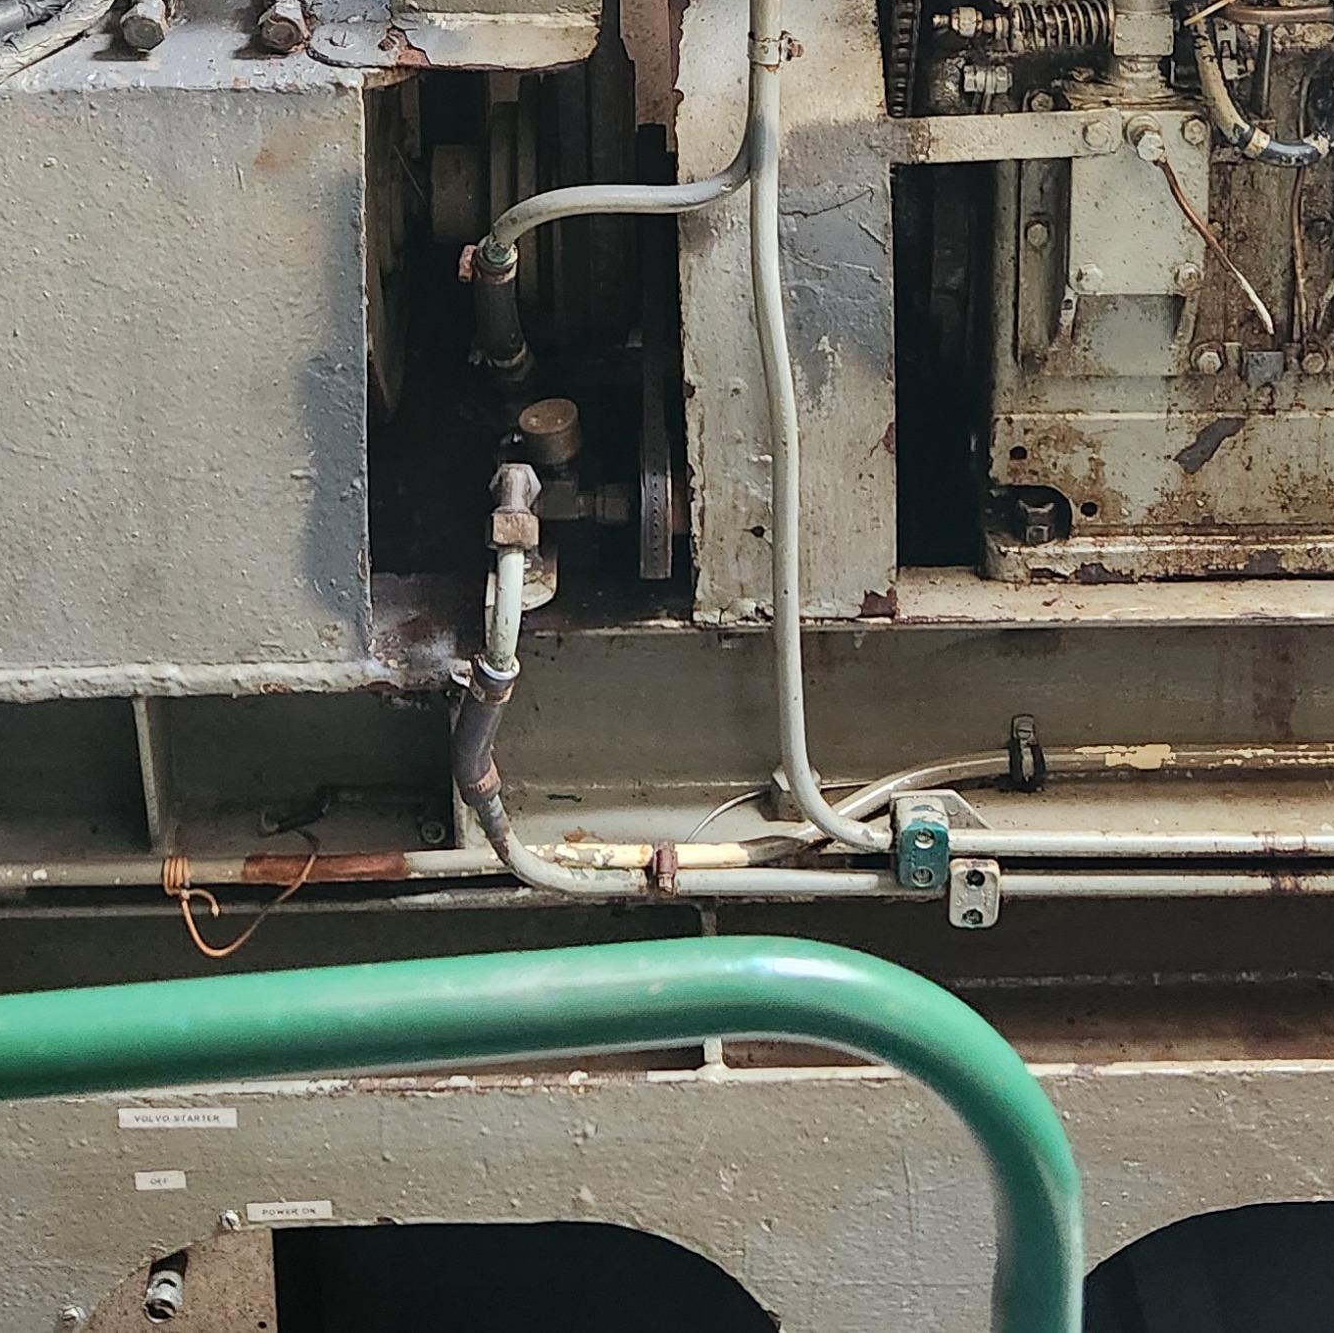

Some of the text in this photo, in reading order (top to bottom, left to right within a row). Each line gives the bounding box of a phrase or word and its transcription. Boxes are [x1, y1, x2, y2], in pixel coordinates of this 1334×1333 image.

[134, 1112, 221, 1123] VOLVO STARTER
[261, 1206, 317, 1217] POWER ON
